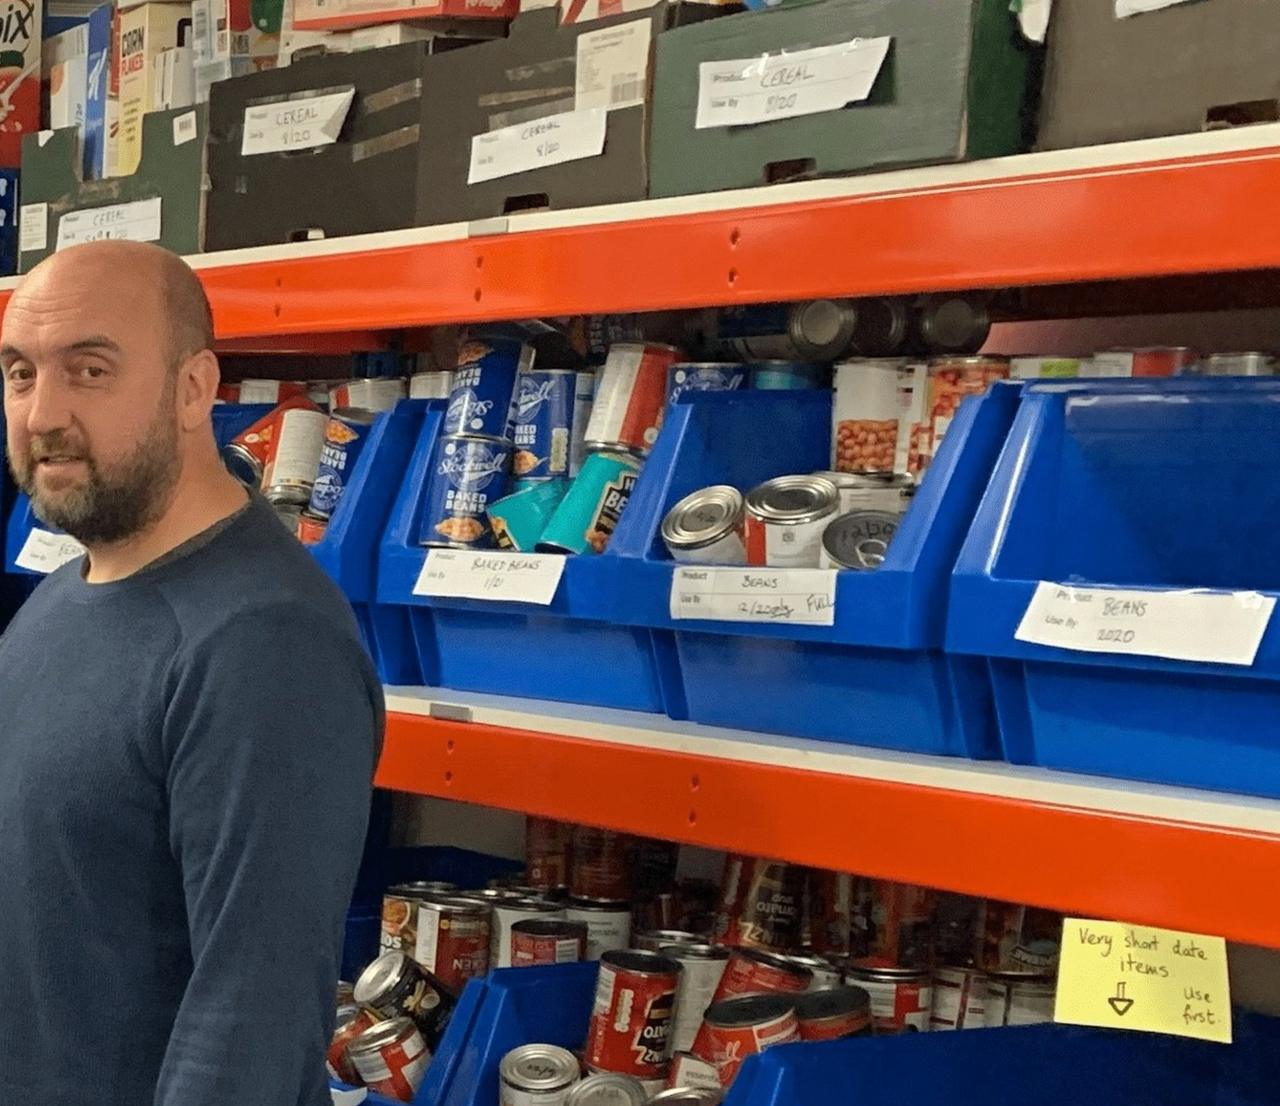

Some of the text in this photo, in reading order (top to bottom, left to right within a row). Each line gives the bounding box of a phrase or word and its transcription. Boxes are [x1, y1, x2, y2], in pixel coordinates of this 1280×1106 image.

[120, 25, 145, 58] CORN
[120, 52, 145, 77] FLAKES
[760, 67, 816, 89] CEREAL
[275, 106, 319, 126] CEREAL
[437, 451, 508, 476] Stockwell
[445, 490, 488, 505] BAKED
[445, 500, 486, 514] BEANS
[508, 559, 543, 572] BEANS
[741, 575, 779, 589] BEANS
[806, 594, 836, 614] FULL
[1102, 597, 1149, 617] BEANS
[1096, 628, 1137, 644] 2020
[1078, 928, 1209, 961] Very short date
[1119, 957, 1170, 979] items
